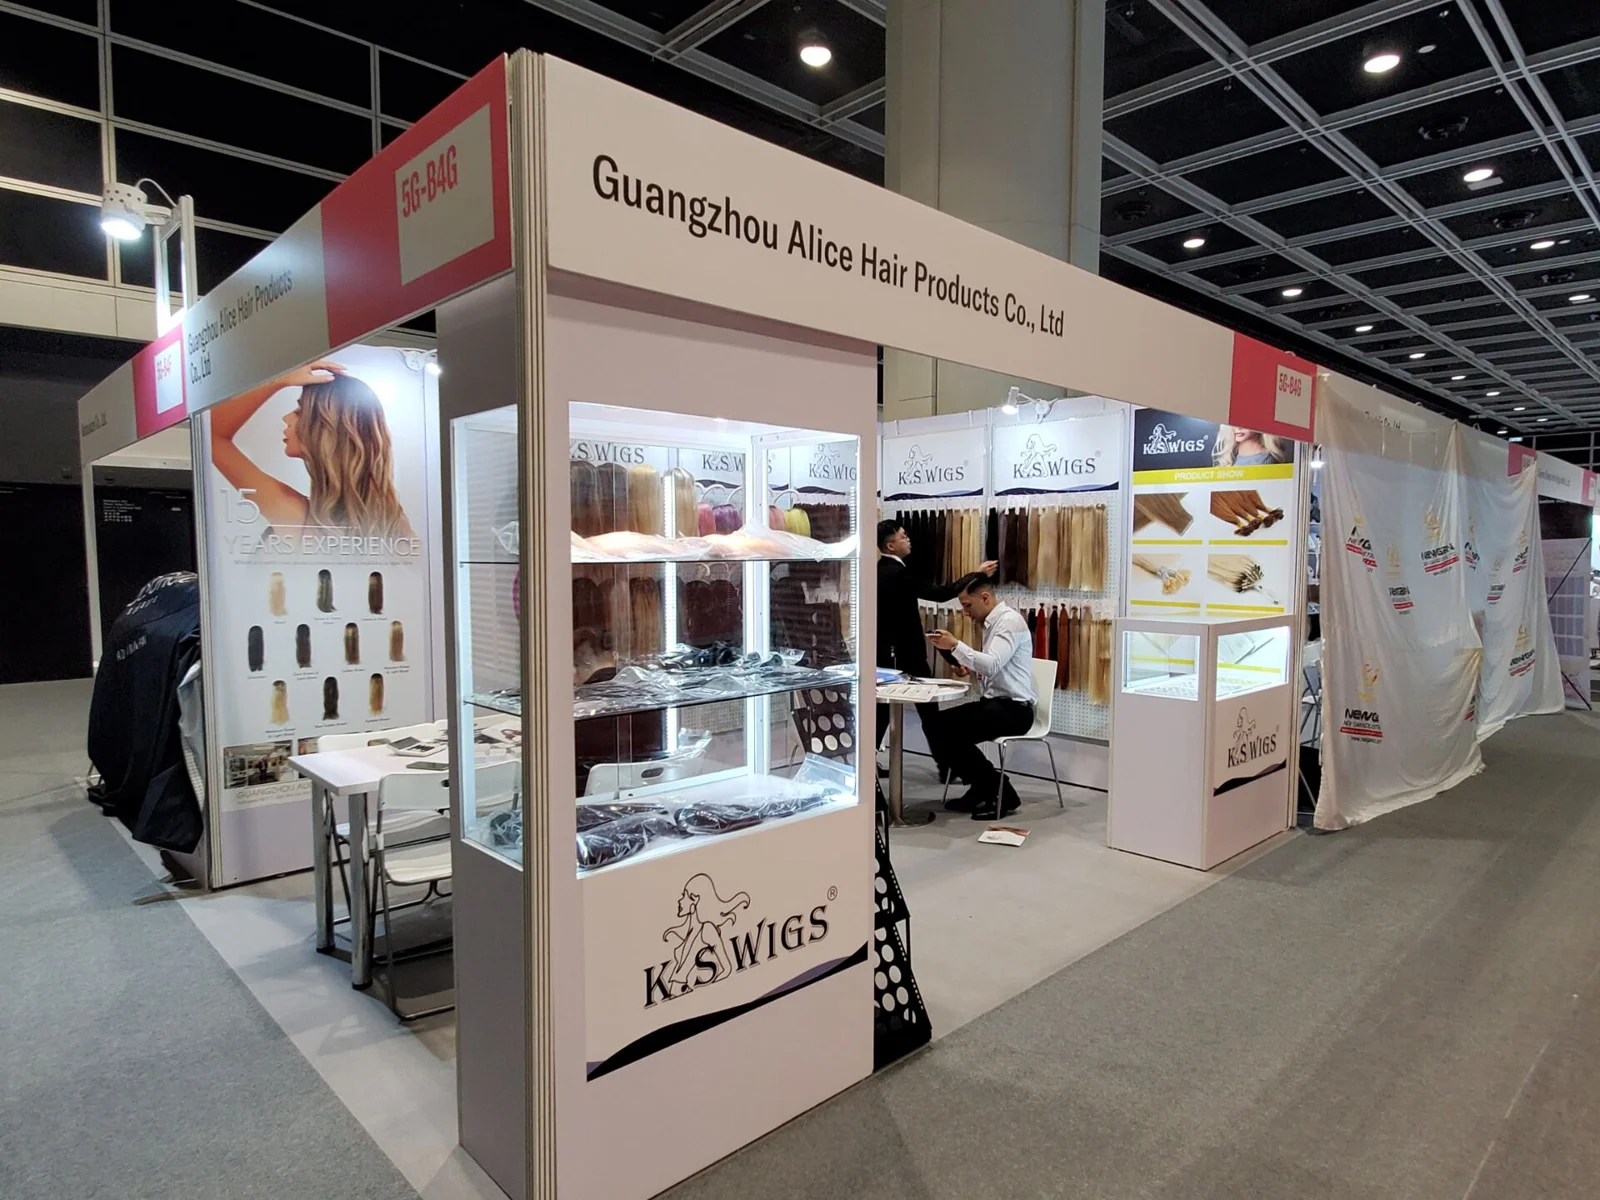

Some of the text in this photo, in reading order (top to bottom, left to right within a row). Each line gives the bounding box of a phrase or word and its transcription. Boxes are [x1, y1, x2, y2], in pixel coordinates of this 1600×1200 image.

[402, 145, 458, 218] 5G-B4G
[592, 153, 1066, 338] Guangzhou Alice Hair Products Co., Ltd
[187, 269, 293, 355] Guangzhou Alice Hair Products
[1173, 469, 1245, 481] PRODUCT SHOW
[220, 488, 261, 524] 15
[224, 534, 421, 557] YEARS EXPERIENCE
[236, 784, 296, 800] GUANGZHOU
